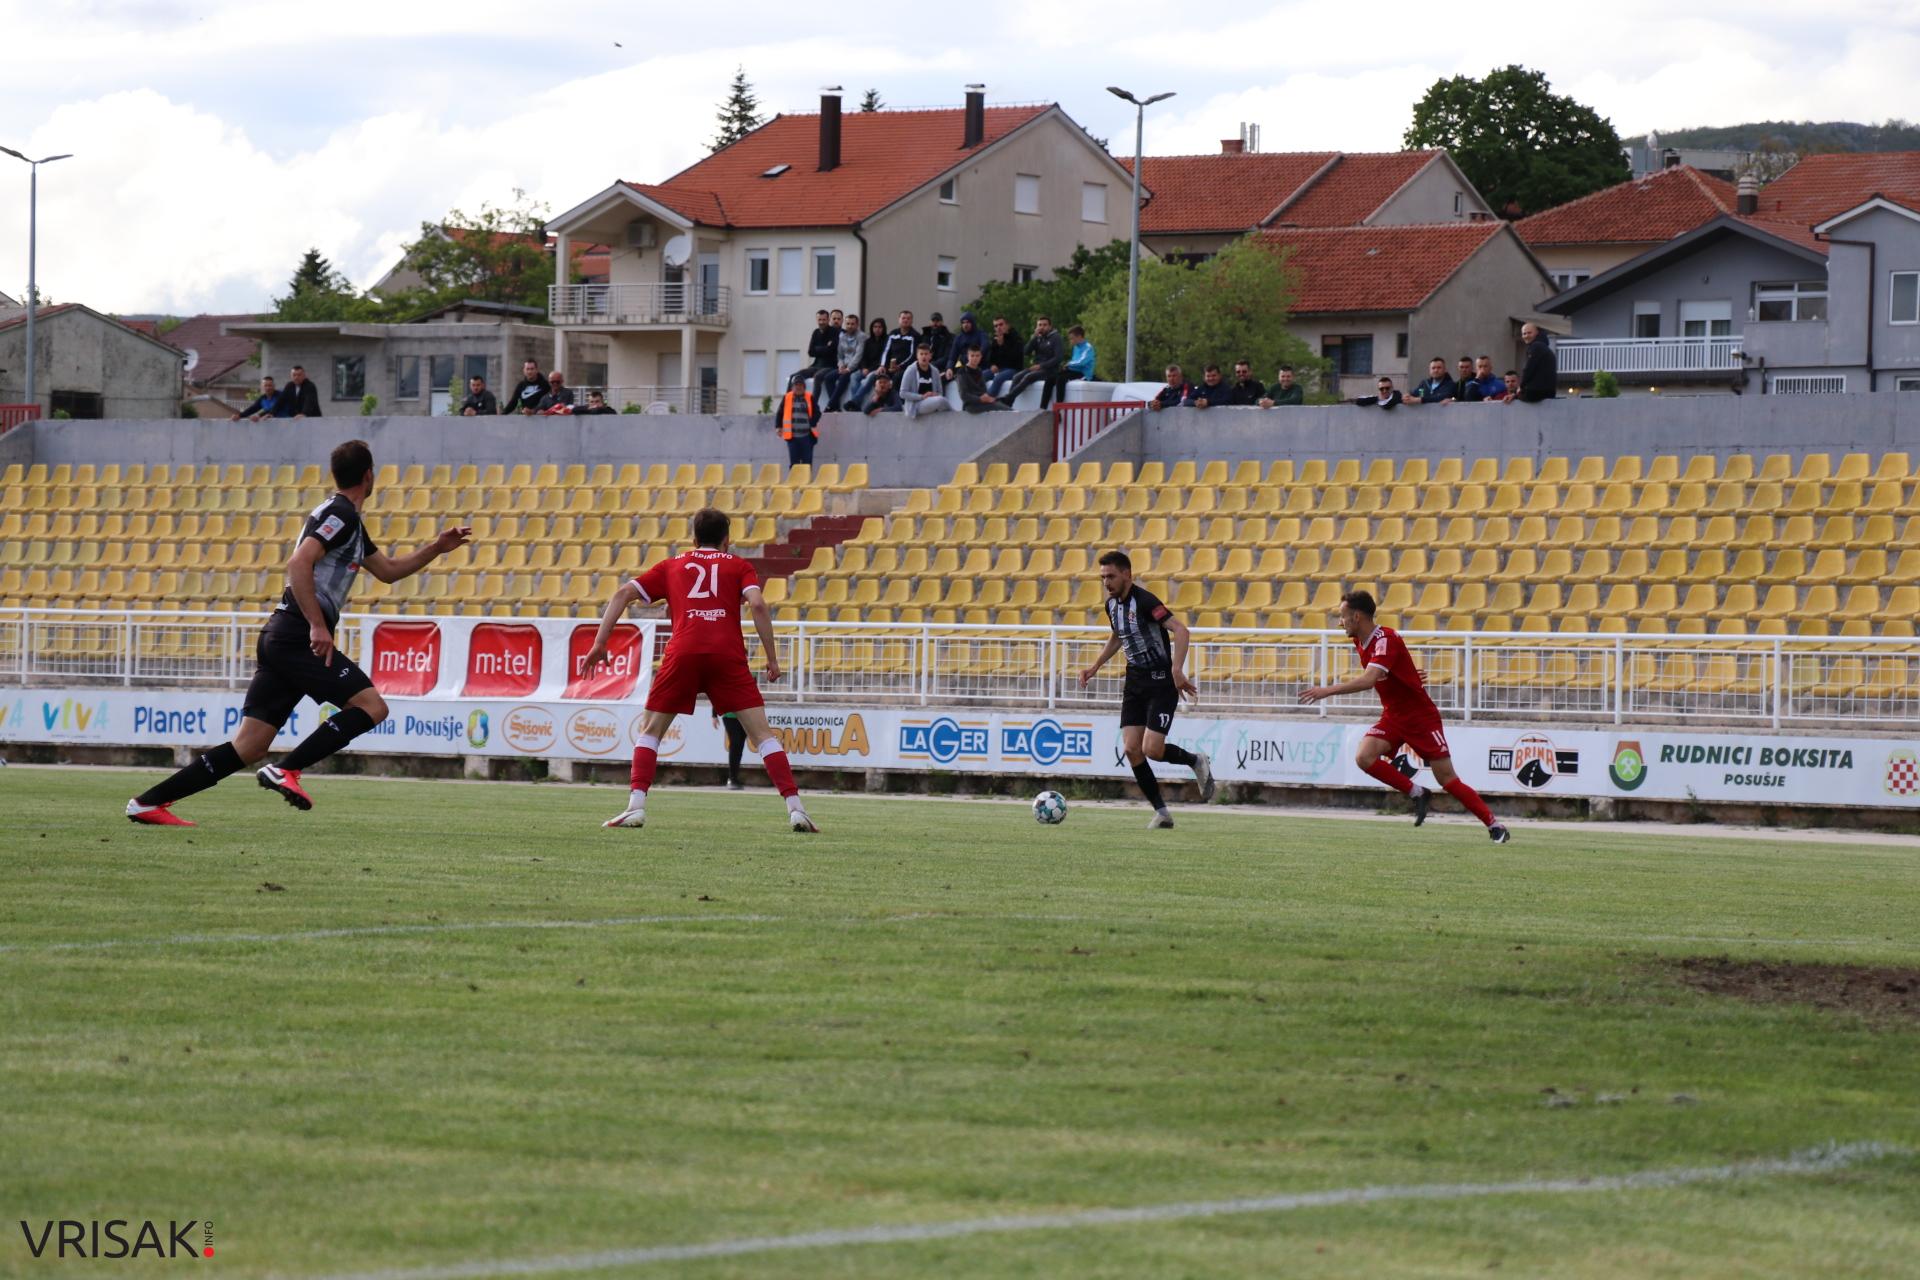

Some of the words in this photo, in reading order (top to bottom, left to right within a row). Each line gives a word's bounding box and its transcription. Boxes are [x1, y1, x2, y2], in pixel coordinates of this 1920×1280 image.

[684, 562, 719, 599] 21
[378, 644, 433, 673] m:tel
[475, 646, 534, 676] m:tel
[134, 705, 207, 734] Planet
[404, 715, 464, 741] Posušje
[794, 717, 844, 727] KLADIONICA
[1158, 713, 1170, 728] 17
[901, 719, 986, 761] LAGER
[1002, 721, 1090, 763] LAGER
[1250, 740, 1341, 764] BINVEST
[1490, 751, 1511, 769] KTM
[1660, 744, 1752, 765] RUDNICI
[1759, 747, 1854, 769] BOKSITA
[1723, 771, 1786, 787] POSUŠJE
